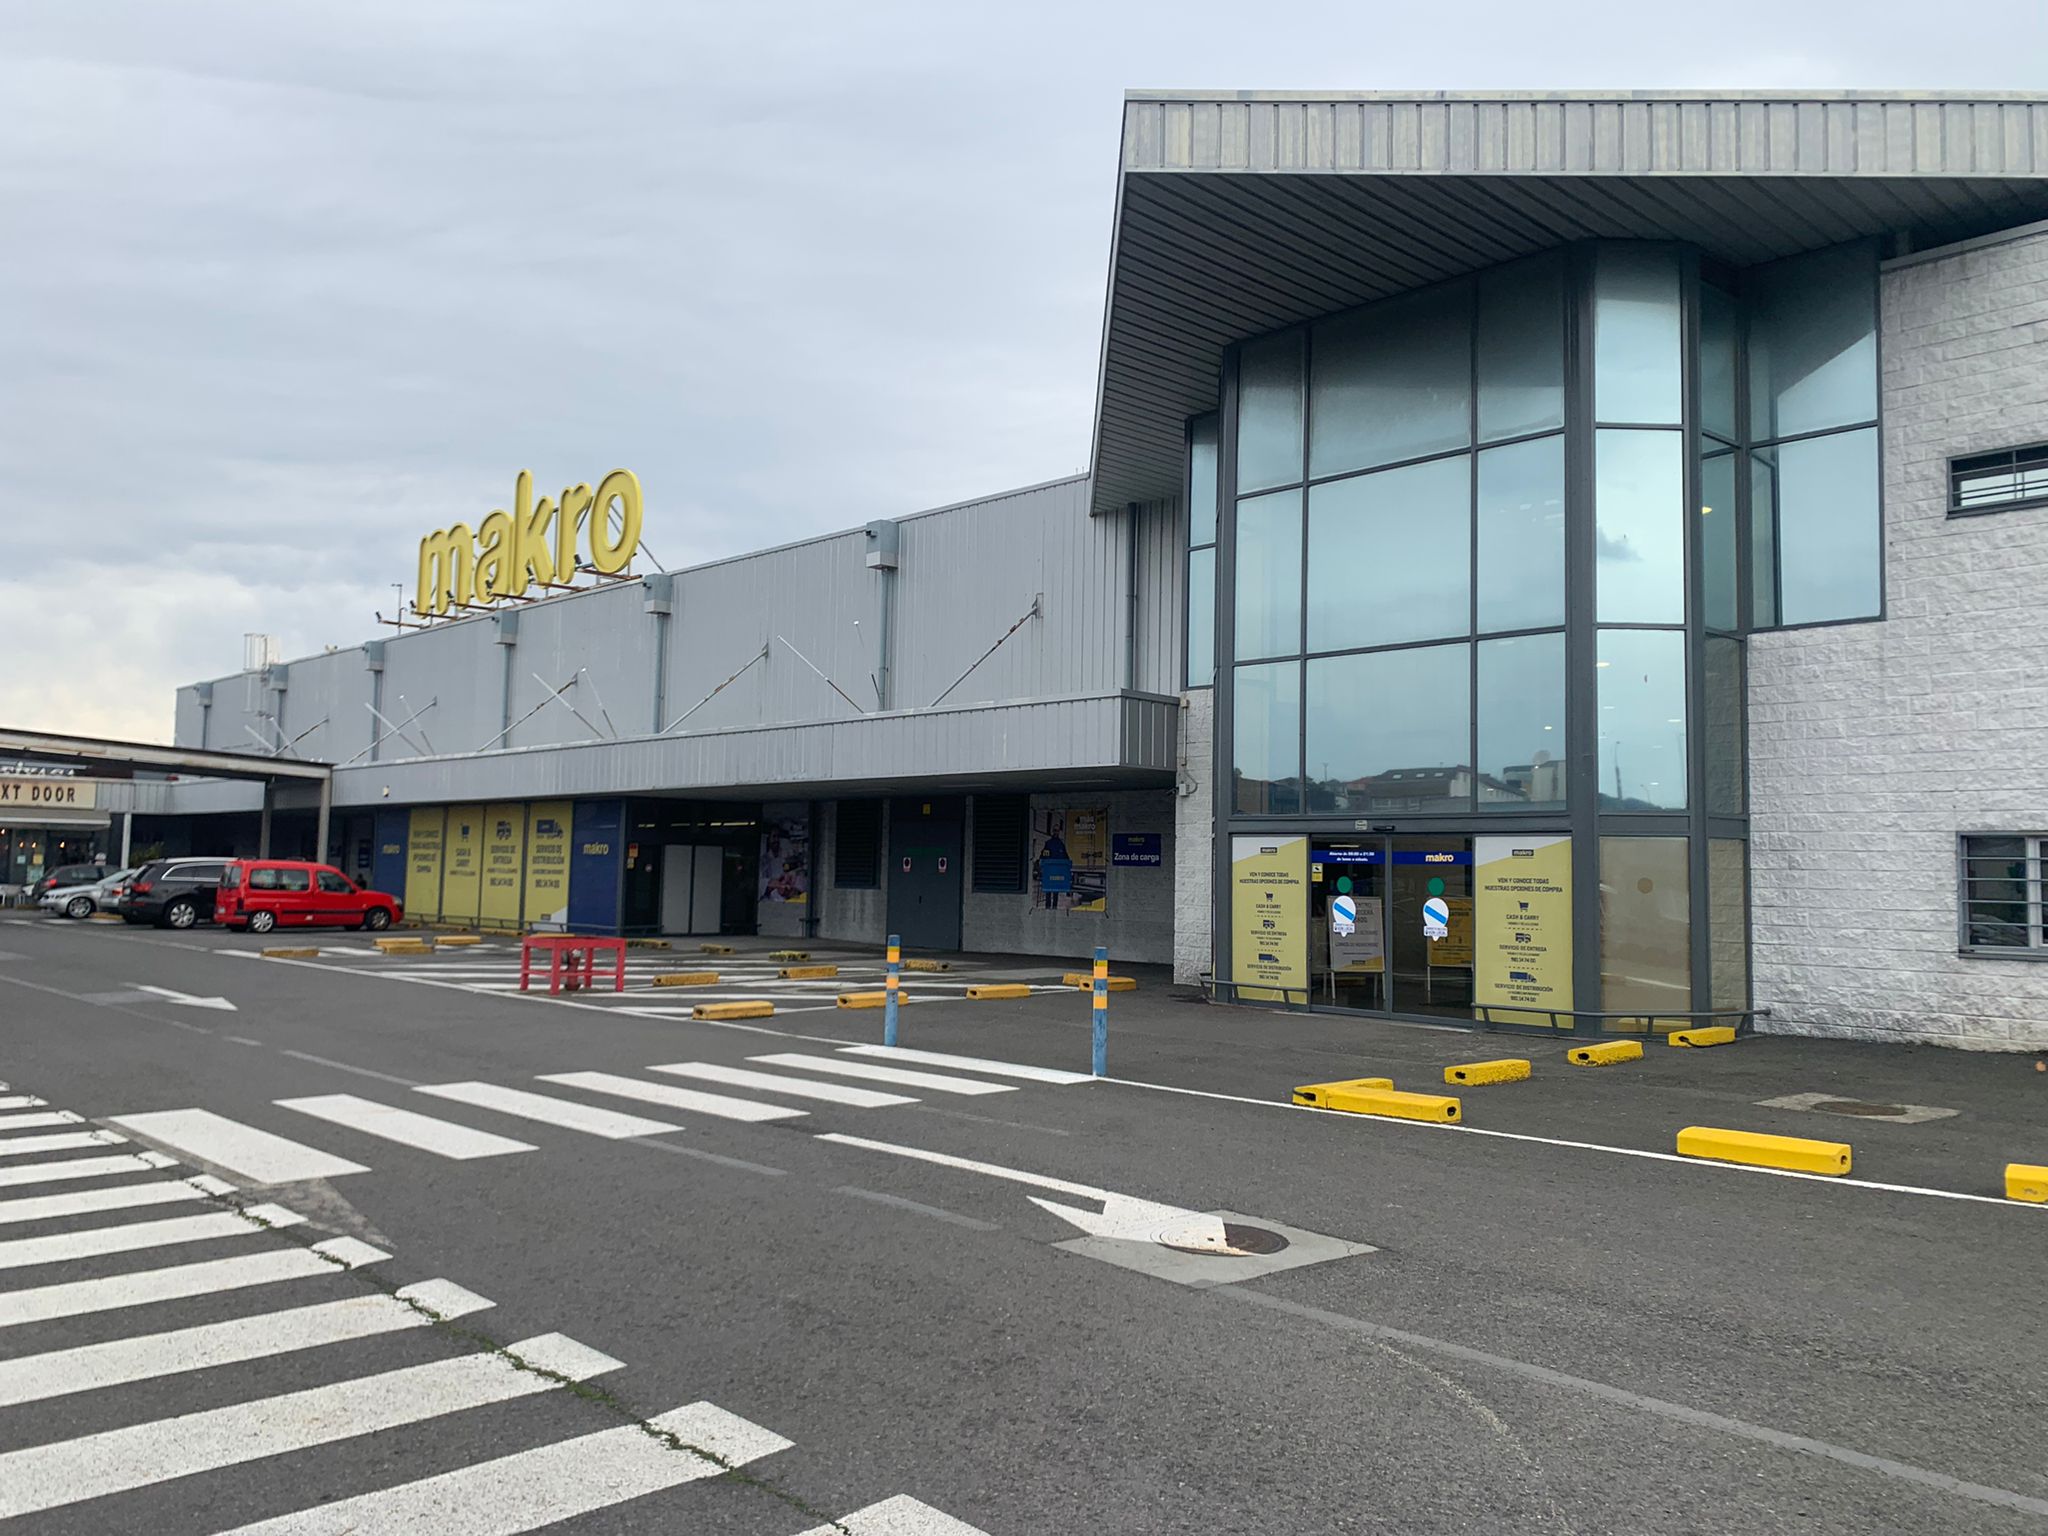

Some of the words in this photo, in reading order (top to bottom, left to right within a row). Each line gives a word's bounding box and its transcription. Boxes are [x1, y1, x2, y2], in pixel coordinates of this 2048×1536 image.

[417, 468, 644, 619] makro
[32, 786, 76, 802] DOOR
[583, 842, 609, 855] makro
[1114, 852, 1130, 861] Zona
[1131, 852, 1139, 861] de
[1139, 854, 1159, 863] carga
[1425, 853, 1454, 862] makro
